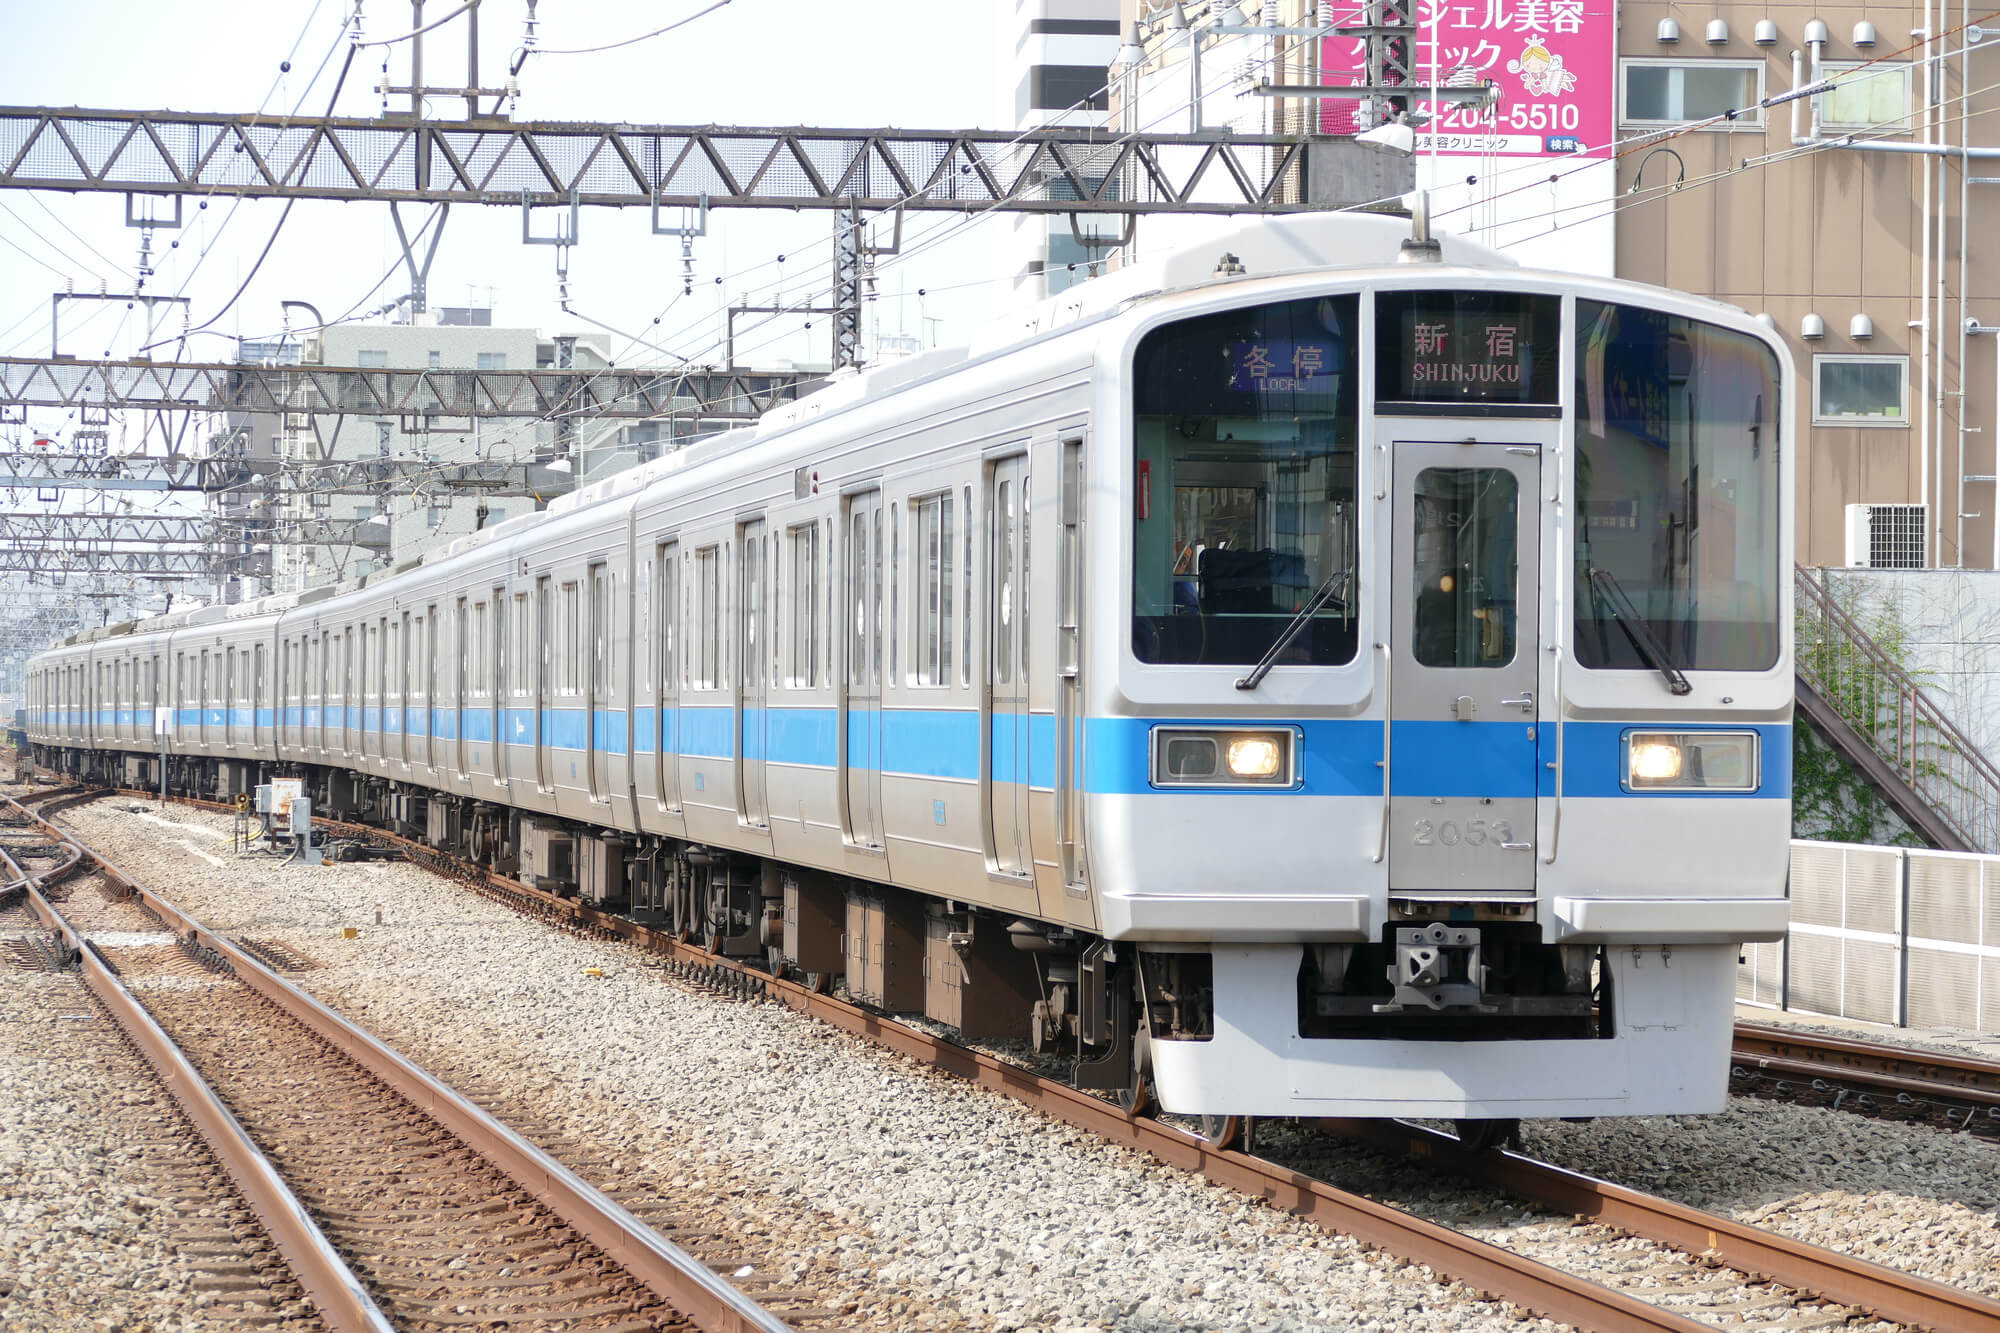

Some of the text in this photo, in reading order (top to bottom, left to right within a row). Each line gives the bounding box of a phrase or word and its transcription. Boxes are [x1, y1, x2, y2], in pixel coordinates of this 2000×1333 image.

[1550, 139, 1574, 150] 検索
[1413, 362, 1520, 382] SHINJUKU
[1260, 378, 1305, 391] LOCAL
[1413, 818, 1513, 847] 2053
